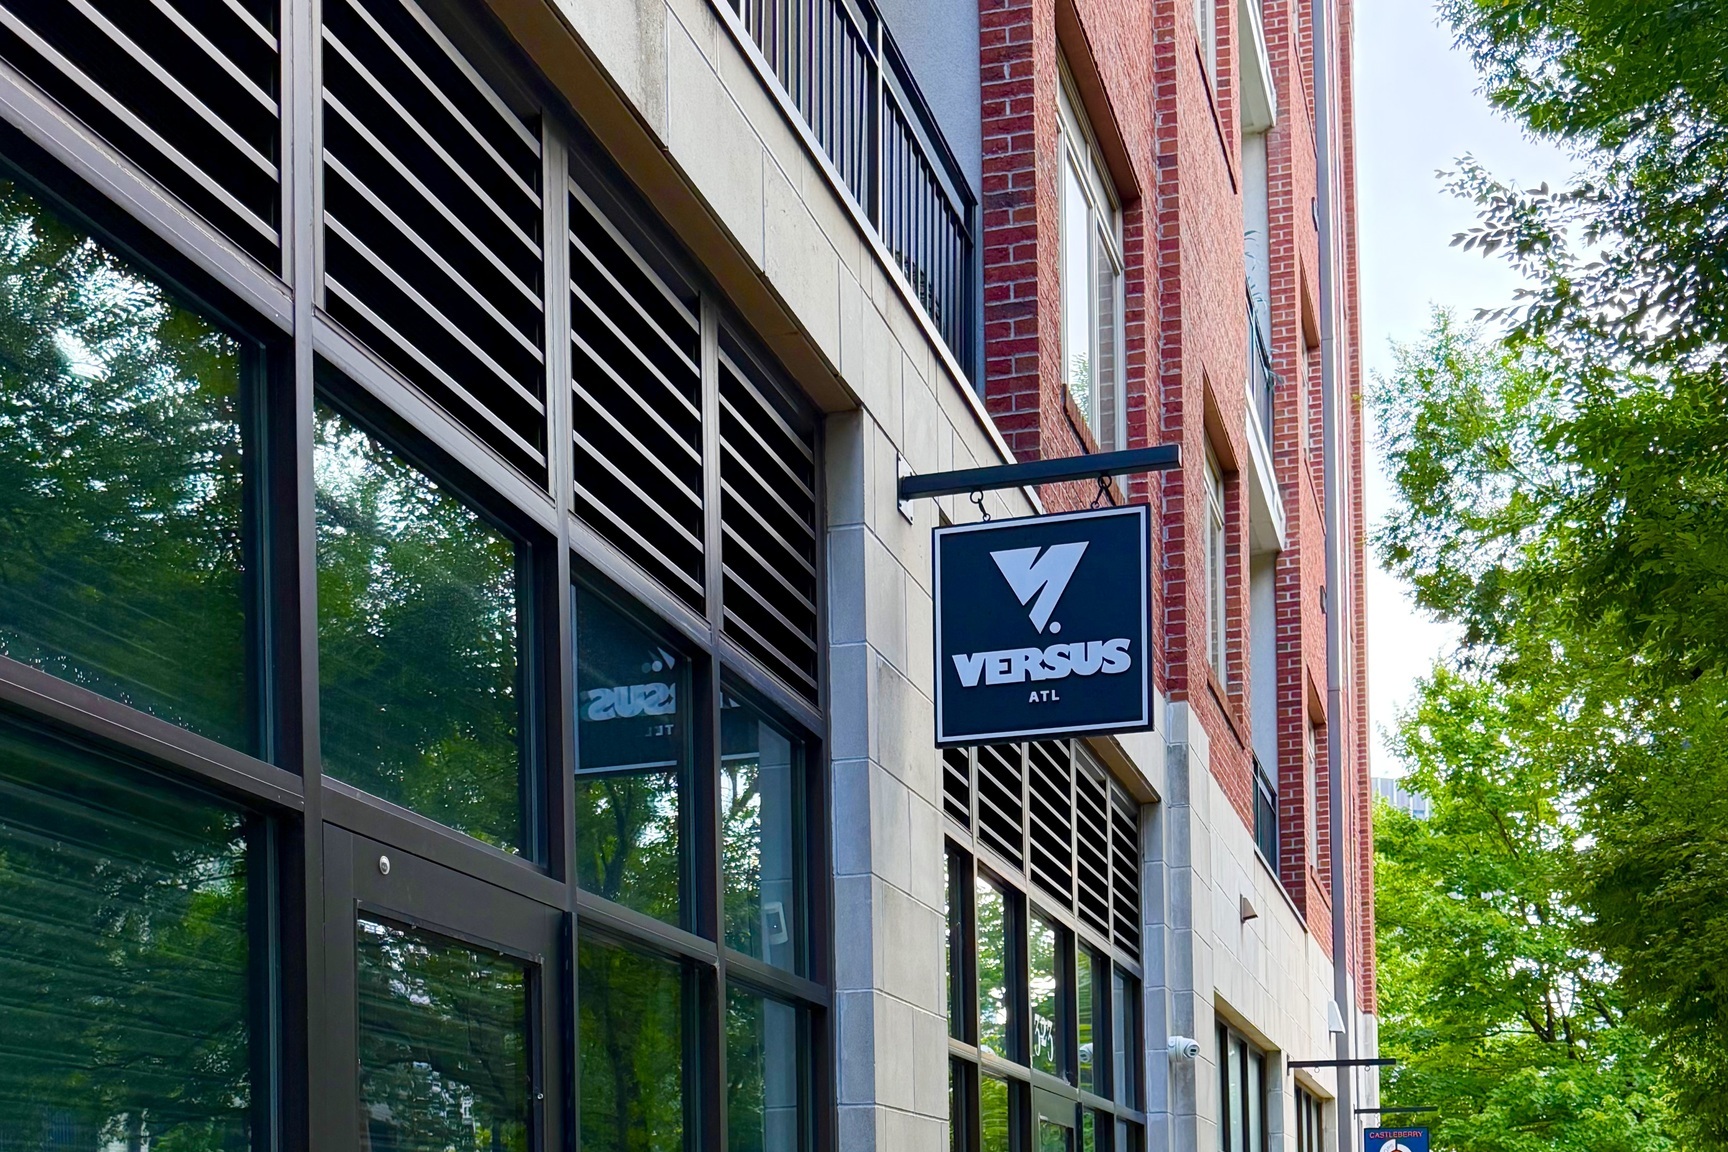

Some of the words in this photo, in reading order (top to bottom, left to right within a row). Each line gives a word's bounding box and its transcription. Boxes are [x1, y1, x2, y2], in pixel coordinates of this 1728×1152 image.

[952, 638, 1132, 688] VERSUS
[1028, 689, 1060, 703] ATL
[1034, 1013, 1054, 1062] 323
[1369, 1130, 1424, 1139] CASTLEBERRY
